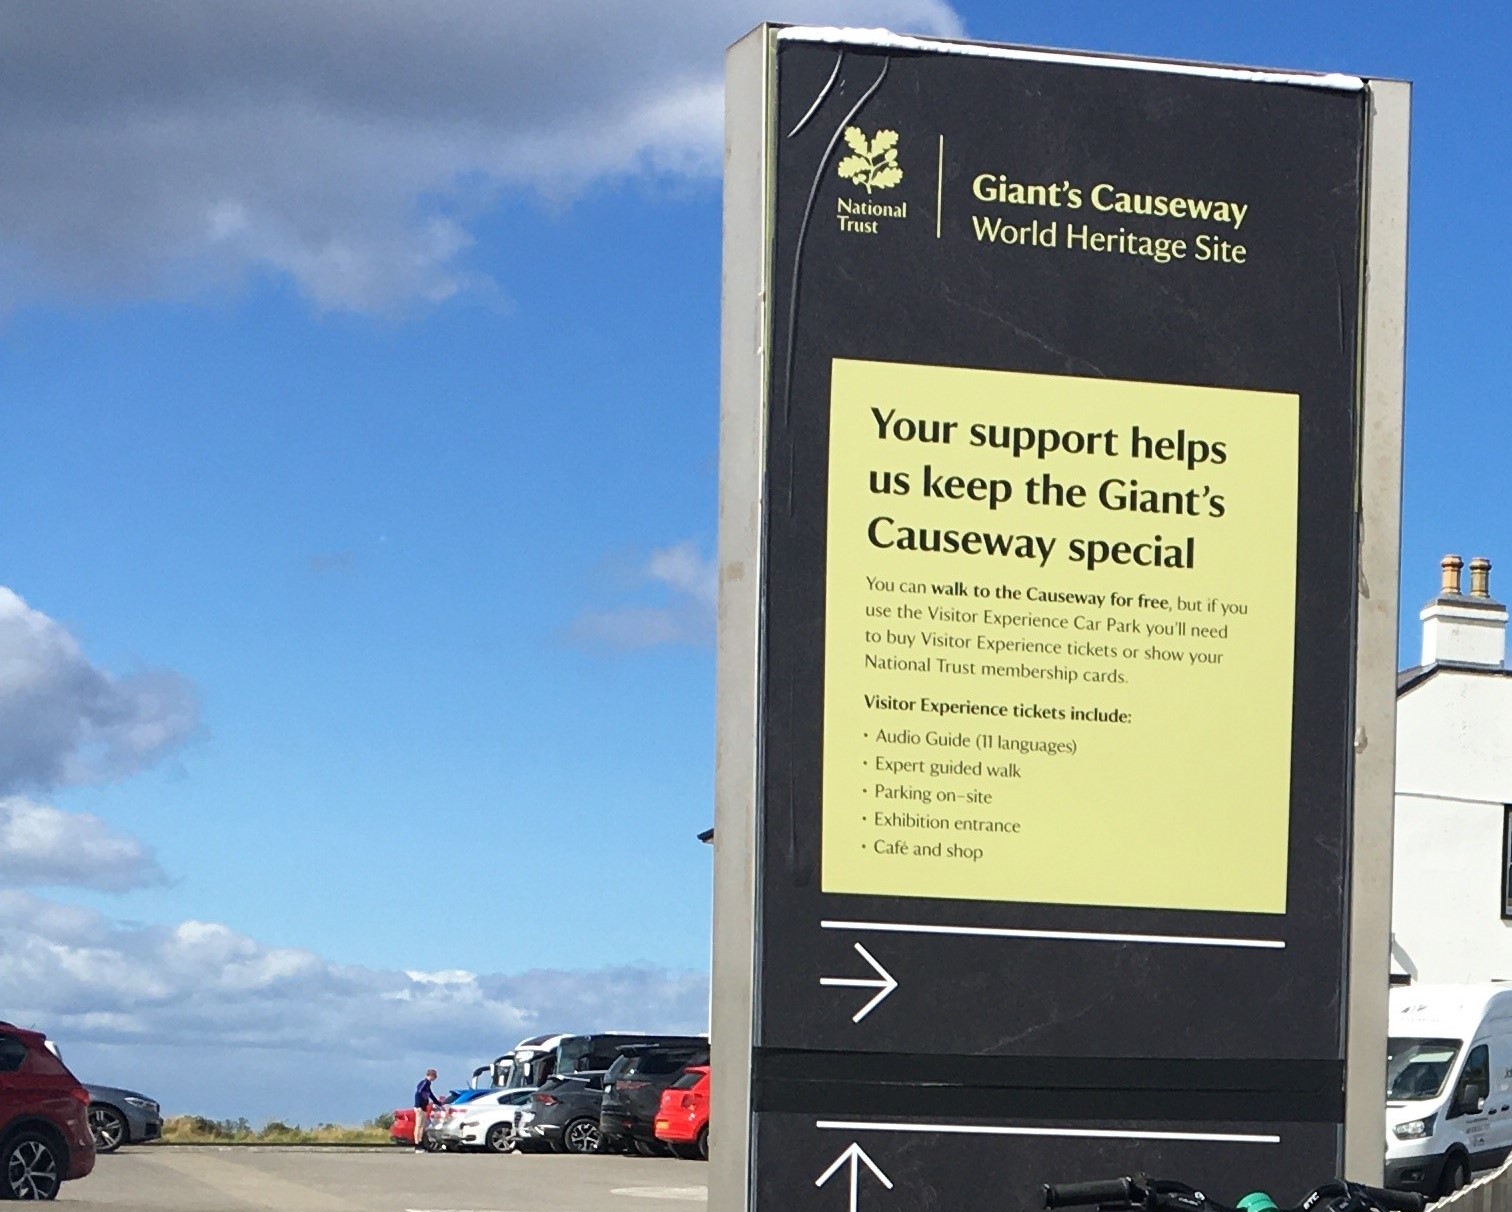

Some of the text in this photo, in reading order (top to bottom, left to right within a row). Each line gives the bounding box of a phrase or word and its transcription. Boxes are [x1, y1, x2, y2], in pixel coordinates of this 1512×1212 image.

[836, 197, 907, 219] National
[972, 173, 1247, 229] Giant's Causeway
[836, 214, 878, 233] Trust
[971, 215, 1246, 263] World Heritage Site
[870, 407, 1226, 470] Your support helps
[869, 464, 1225, 517] us keep the Giant's
[867, 516, 1194, 570] Causeway special
[865, 575, 1247, 616] You can walk to the Causeway for free, but if you
[865, 603, 1227, 638] use the Visitor Experience Car Park you'll need
[864, 628, 1223, 665] to buy Visitor Experience tickets or show your
[864, 653, 1128, 684] National Trust membership cards.
[864, 693, 1131, 723] Visitor Experience tickets include:
[875, 728, 1077, 755] Audio Guide (11 languages)
[875, 755, 1021, 778] Expert guided walk
[874, 783, 992, 804] Parking on-site
[874, 811, 1020, 833] Exhibition entrance
[873, 838, 983, 862] Café and shop
